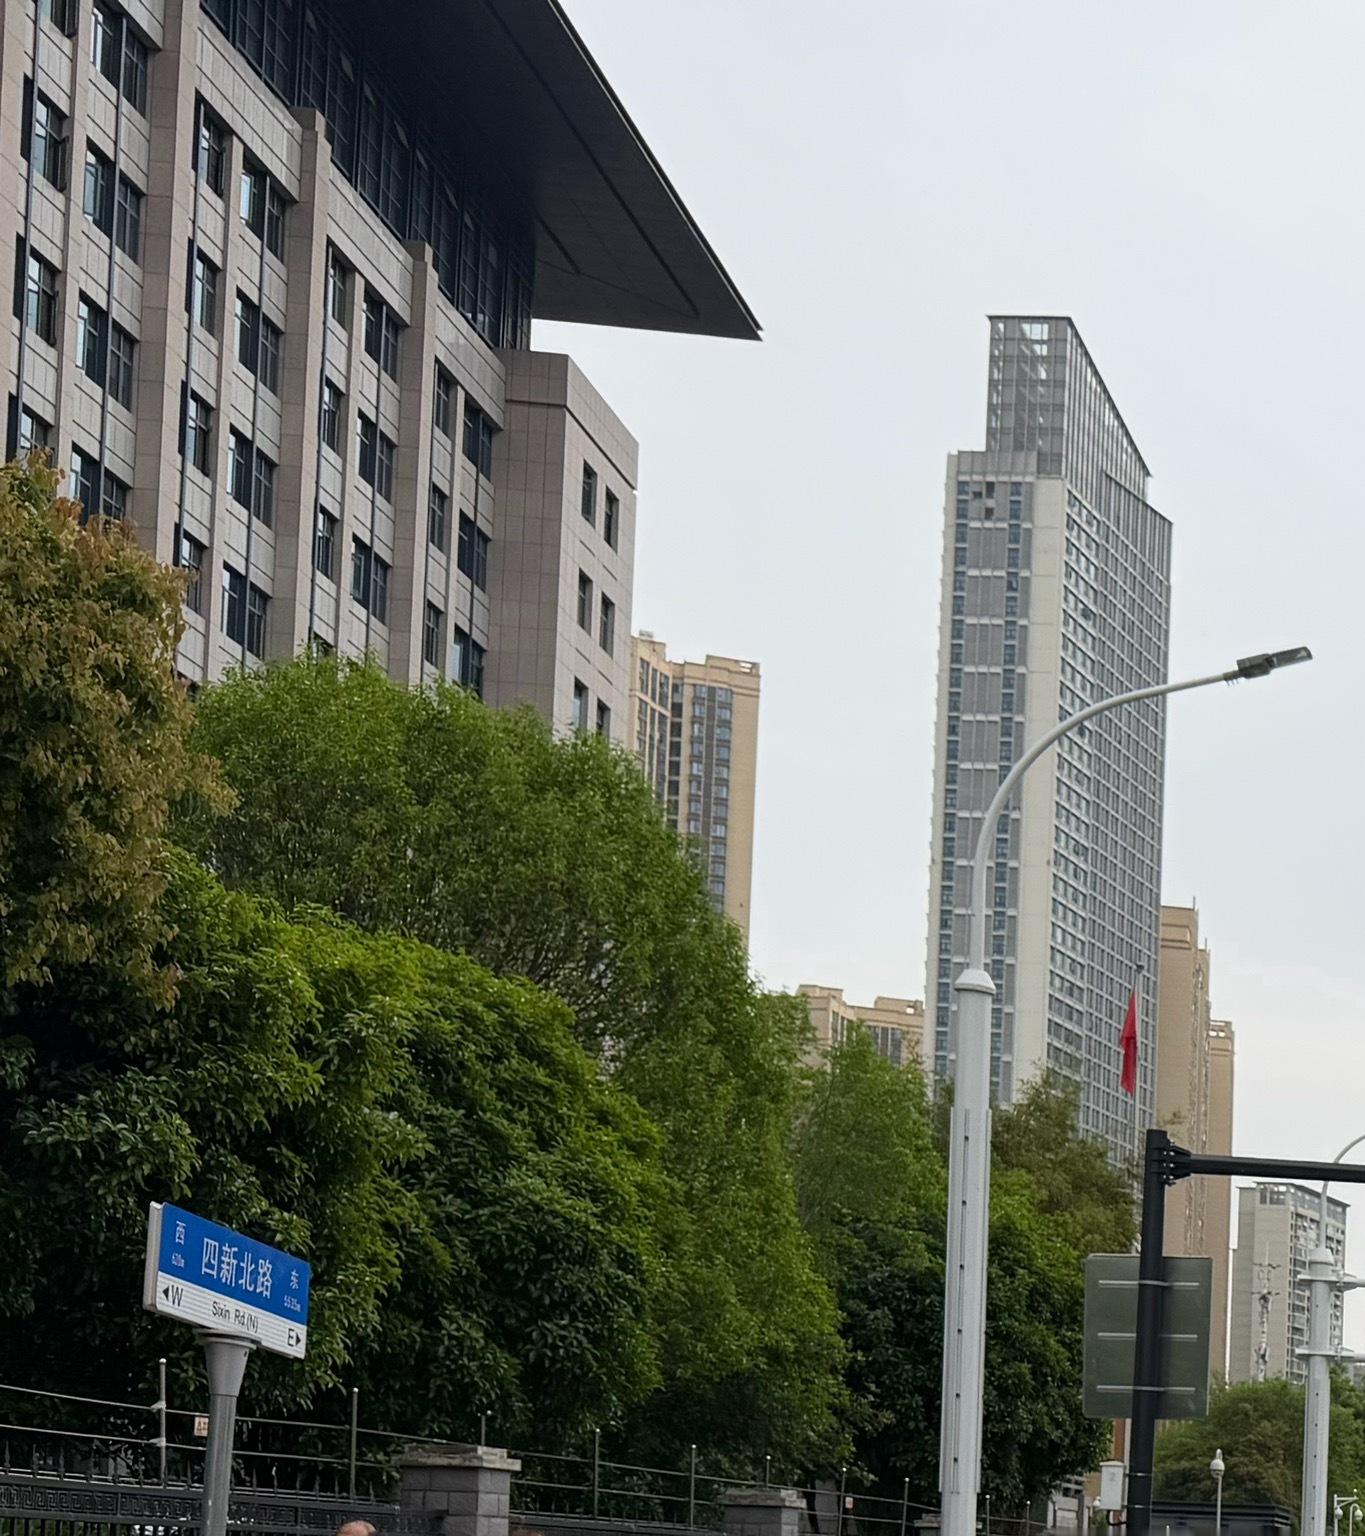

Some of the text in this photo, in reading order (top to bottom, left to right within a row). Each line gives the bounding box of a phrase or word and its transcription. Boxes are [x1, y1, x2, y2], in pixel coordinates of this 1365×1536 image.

[175, 1220, 186, 1245] 西
[201, 1237, 273, 1299] 四新北路
[290, 1269, 299, 1289] 东
[171, 1285, 184, 1307] W
[212, 1301, 230, 1320] Sixin
[287, 1328, 295, 1348] E
